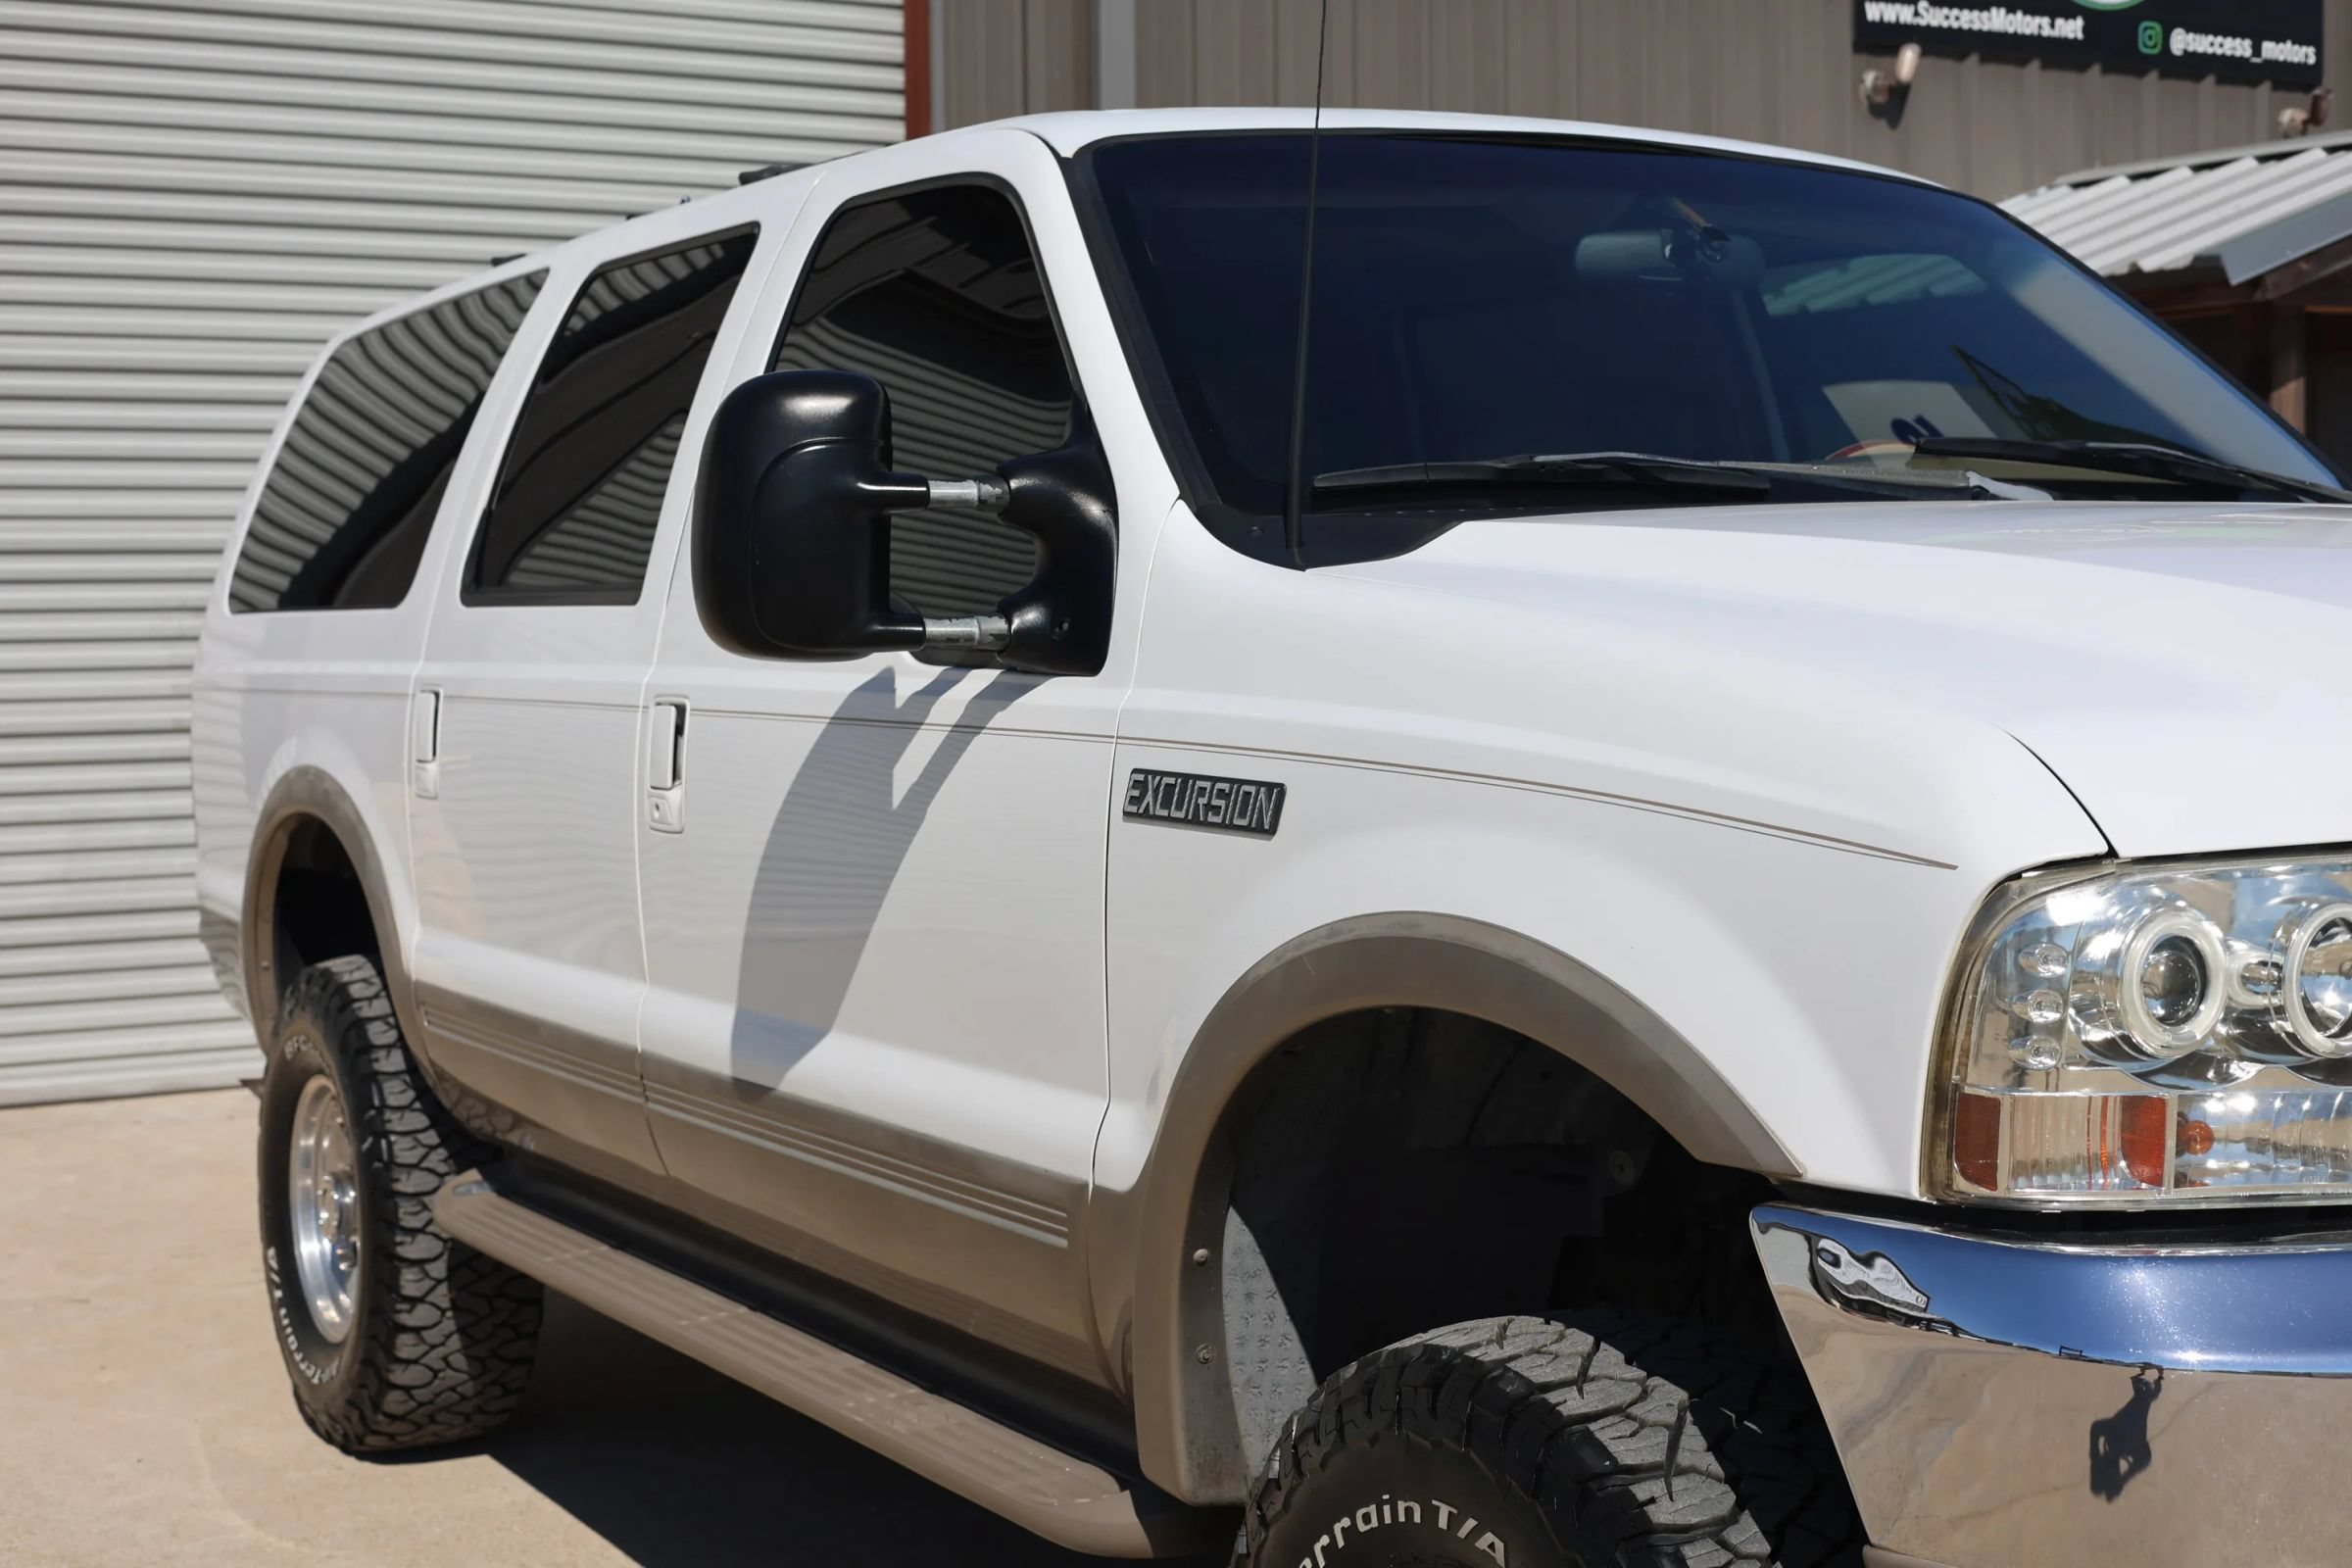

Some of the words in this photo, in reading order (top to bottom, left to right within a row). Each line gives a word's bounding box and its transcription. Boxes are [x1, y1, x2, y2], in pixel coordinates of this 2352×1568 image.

[1864, 0, 2084, 40] www.SuccessMotors.net
[2170, 27, 2317, 65] @success_motors
[1124, 773, 1280, 830] EXCURSION
